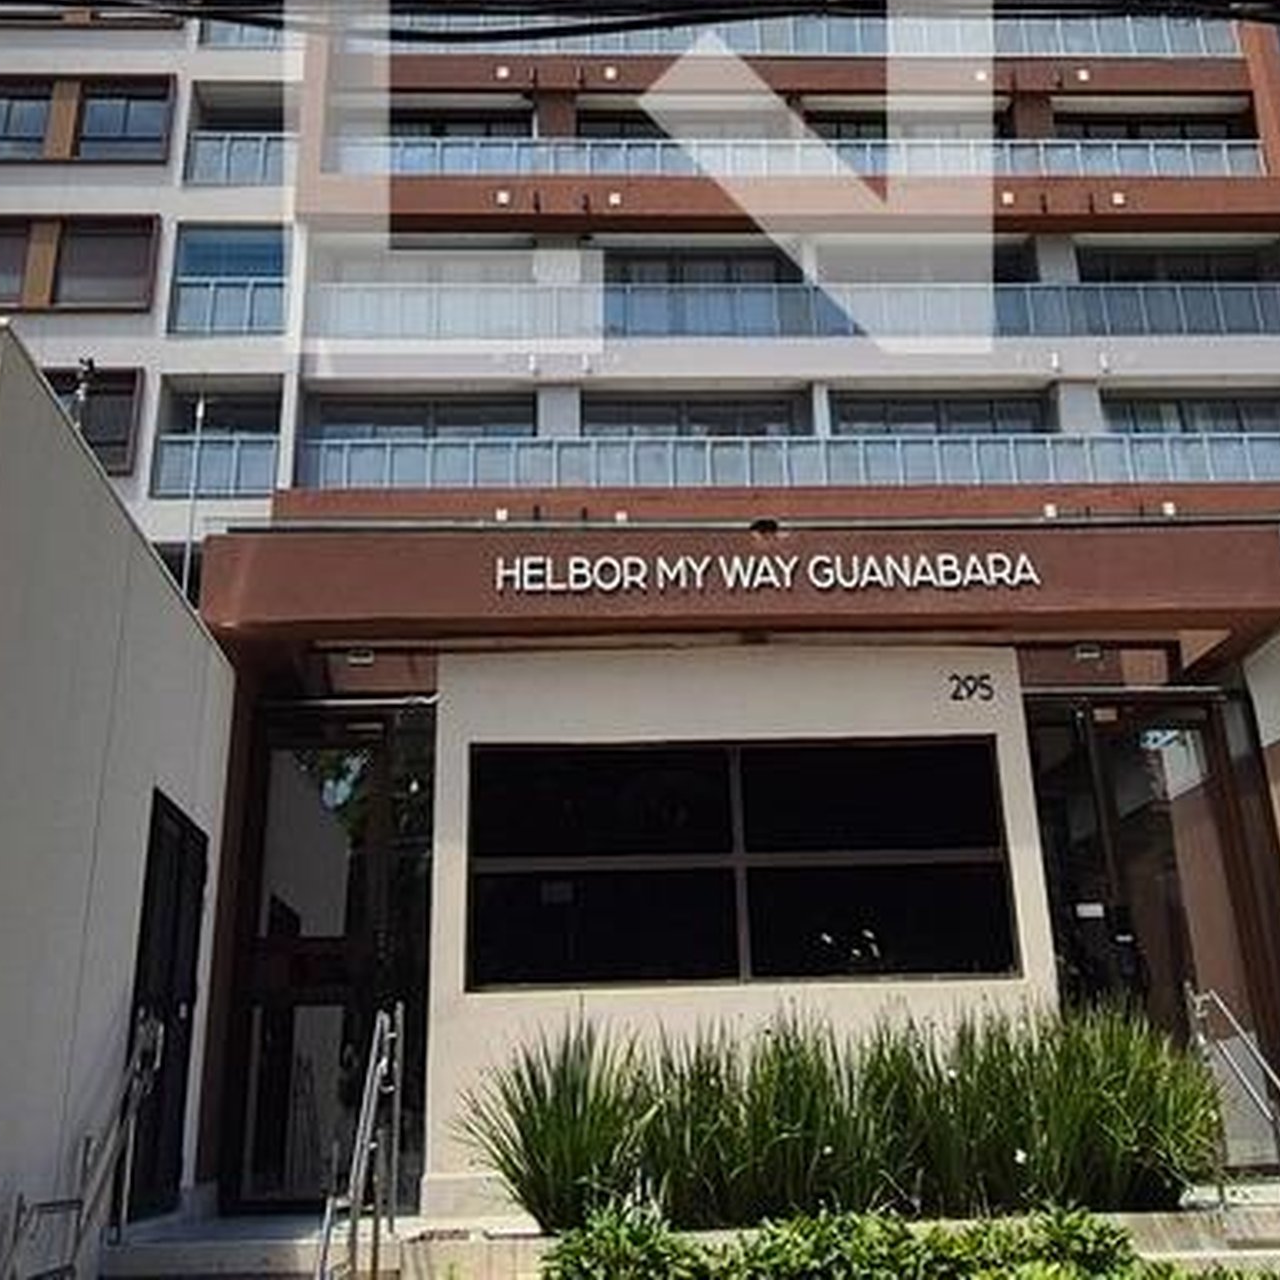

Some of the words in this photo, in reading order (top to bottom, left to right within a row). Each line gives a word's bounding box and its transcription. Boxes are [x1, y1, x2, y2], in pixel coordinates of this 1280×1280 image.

[495, 556, 647, 591] HELBOR
[656, 556, 711, 589] MY
[718, 555, 799, 589] WAY
[808, 553, 1041, 589] GUANABARA
[948, 673, 995, 702] 295
